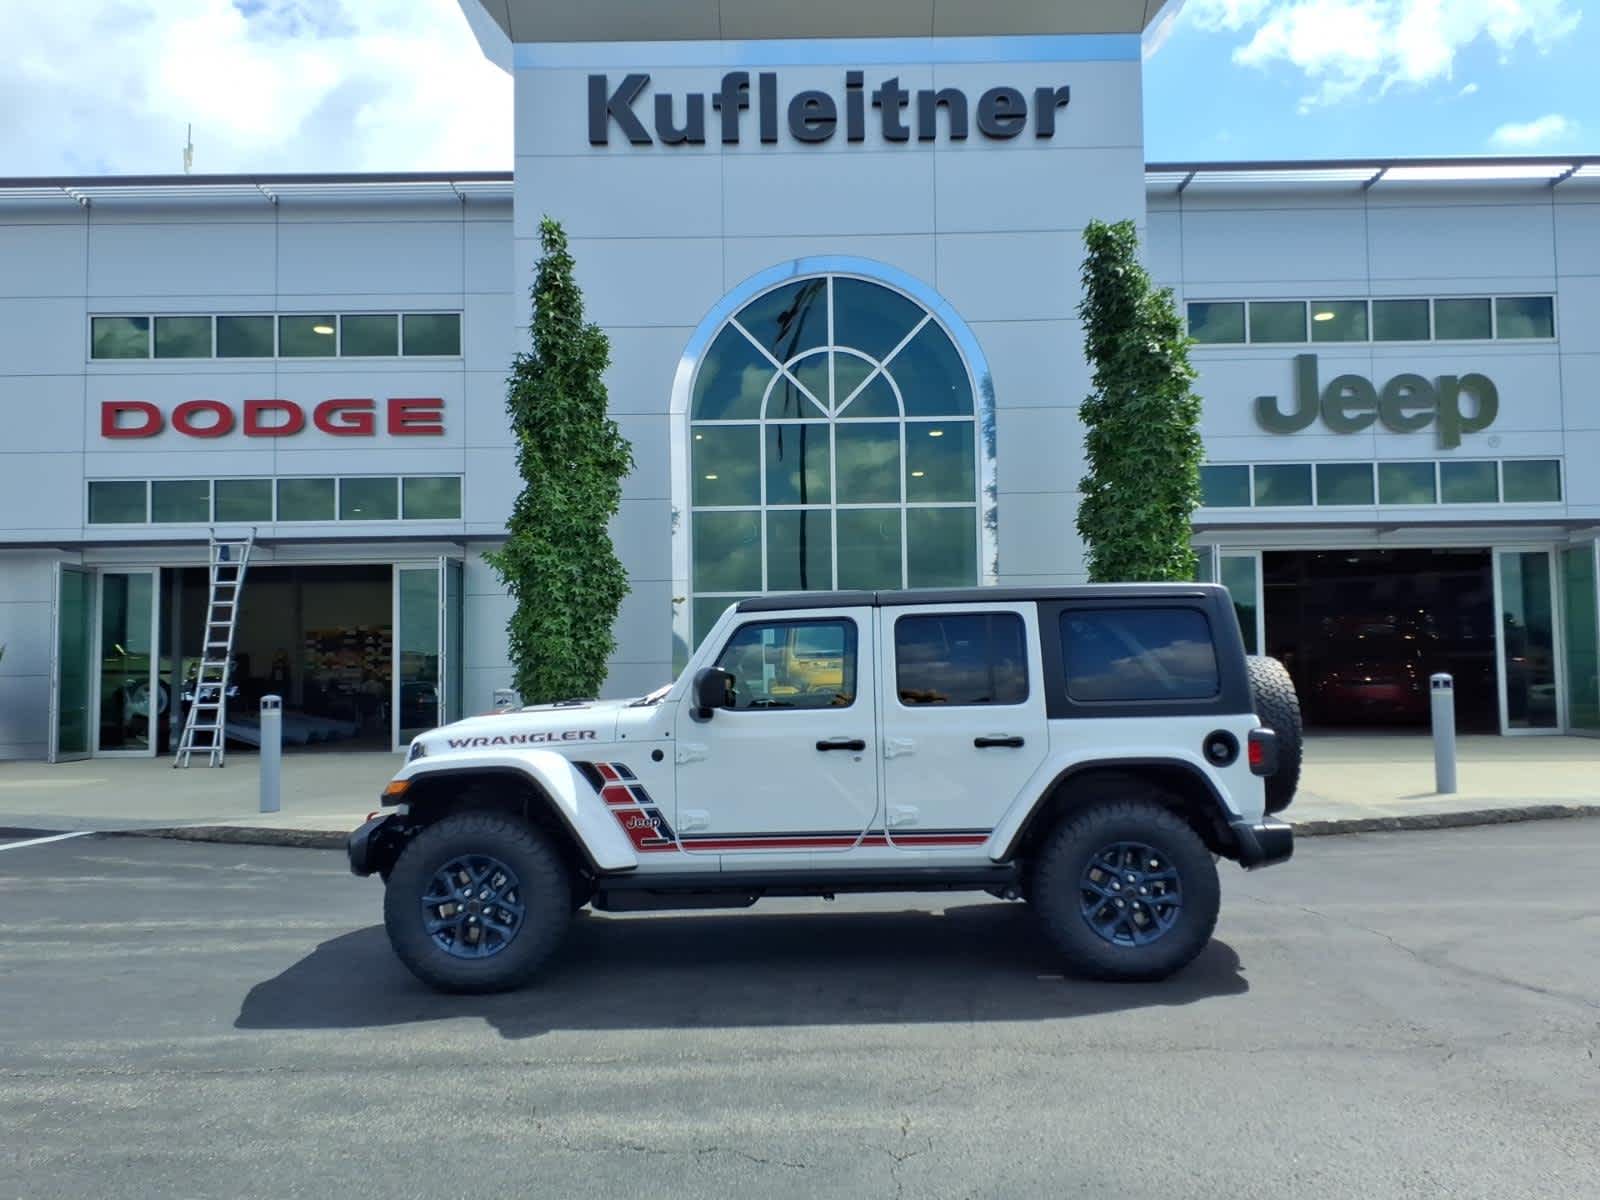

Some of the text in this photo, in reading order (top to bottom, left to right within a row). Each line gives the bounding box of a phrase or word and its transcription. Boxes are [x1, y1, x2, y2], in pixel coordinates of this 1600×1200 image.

[587, 70, 1070, 145] Kufleitner
[101, 398, 444, 438] DODGE
[1255, 353, 1499, 449] Jeep
[448, 730, 596, 748] WRANGLER
[626, 815, 661, 830] Jeep
